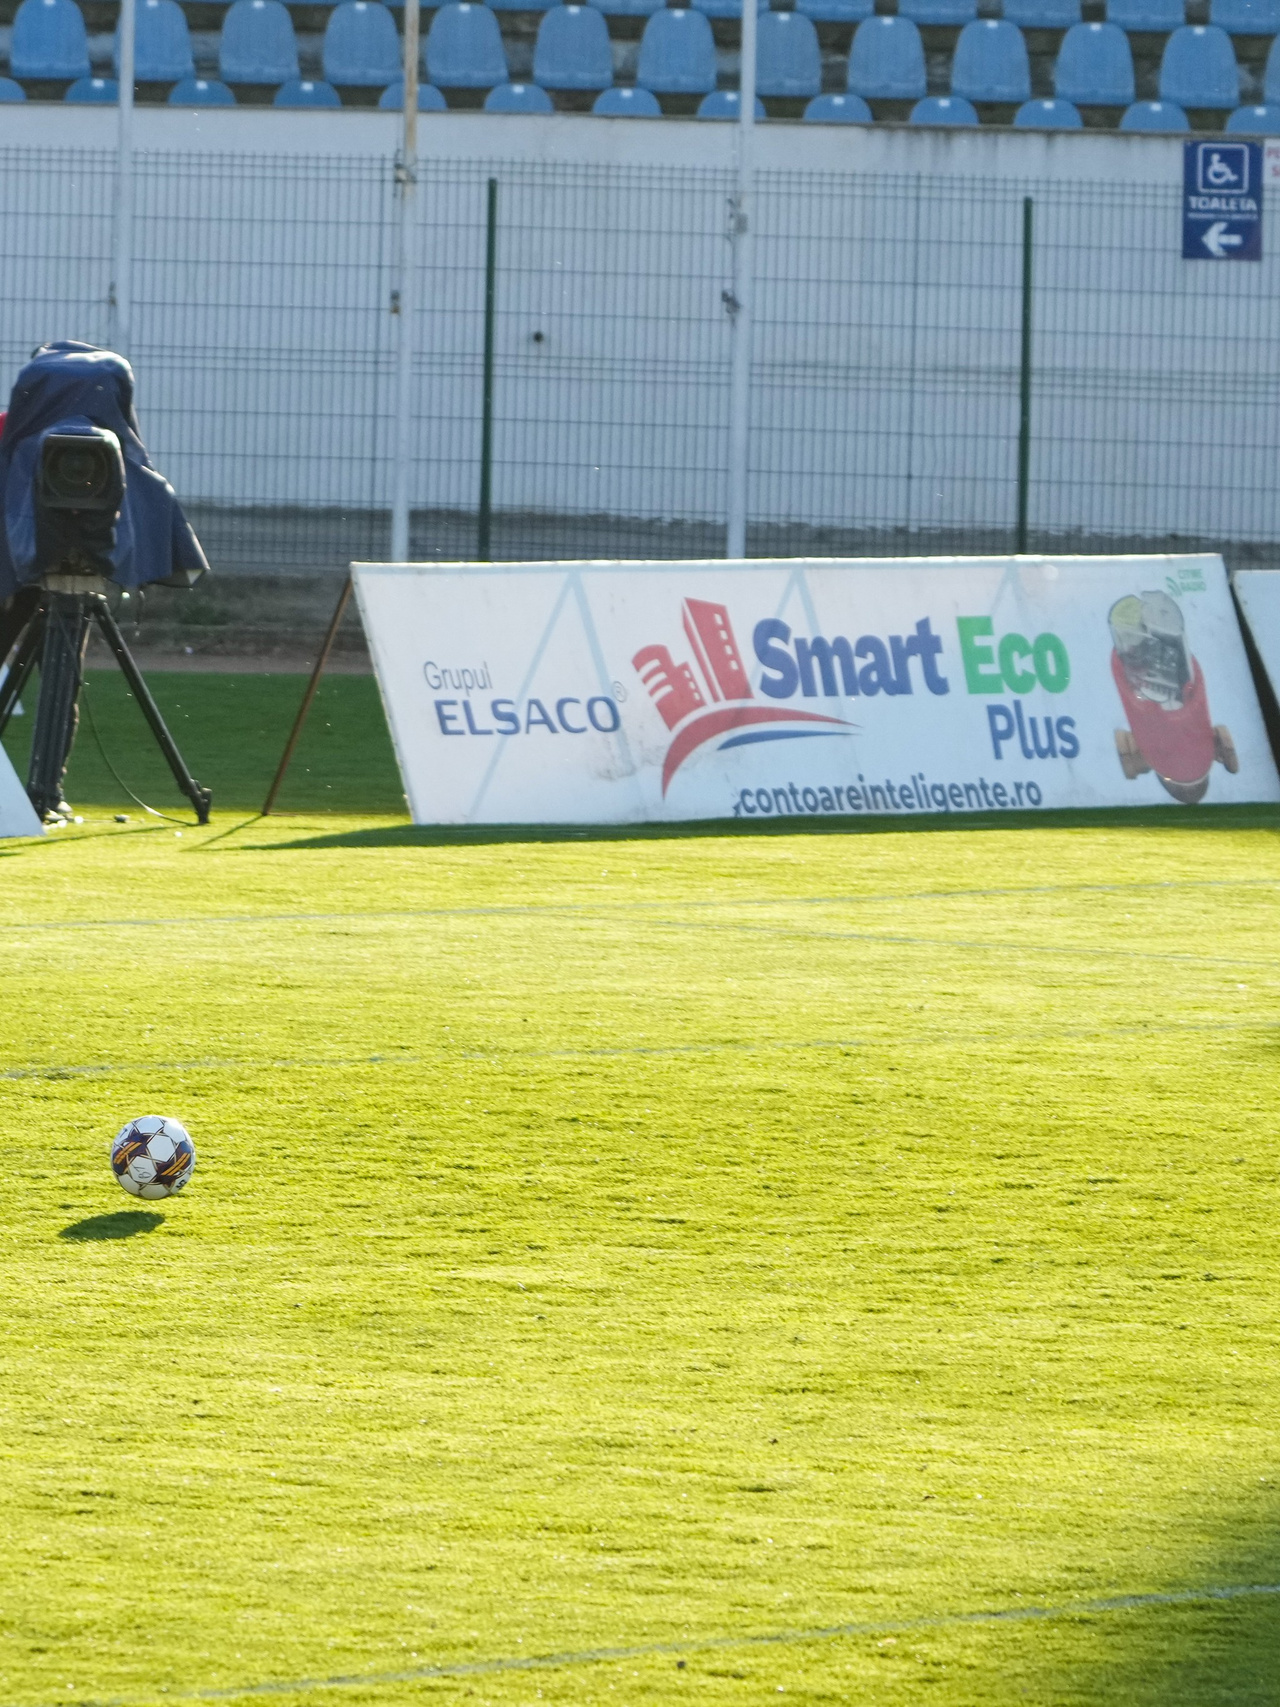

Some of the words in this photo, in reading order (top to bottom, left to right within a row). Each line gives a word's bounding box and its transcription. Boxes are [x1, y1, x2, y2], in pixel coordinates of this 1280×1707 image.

[1189, 196, 1258, 211] TOALETA
[752, 616, 950, 699] Smart
[956, 616, 1070, 695] Eco
[423, 660, 493, 697] Grupul
[434, 696, 620, 735] ELSACO
[986, 699, 1080, 760] Plus
[740, 773, 1043, 814] contoareinteligente.ro
